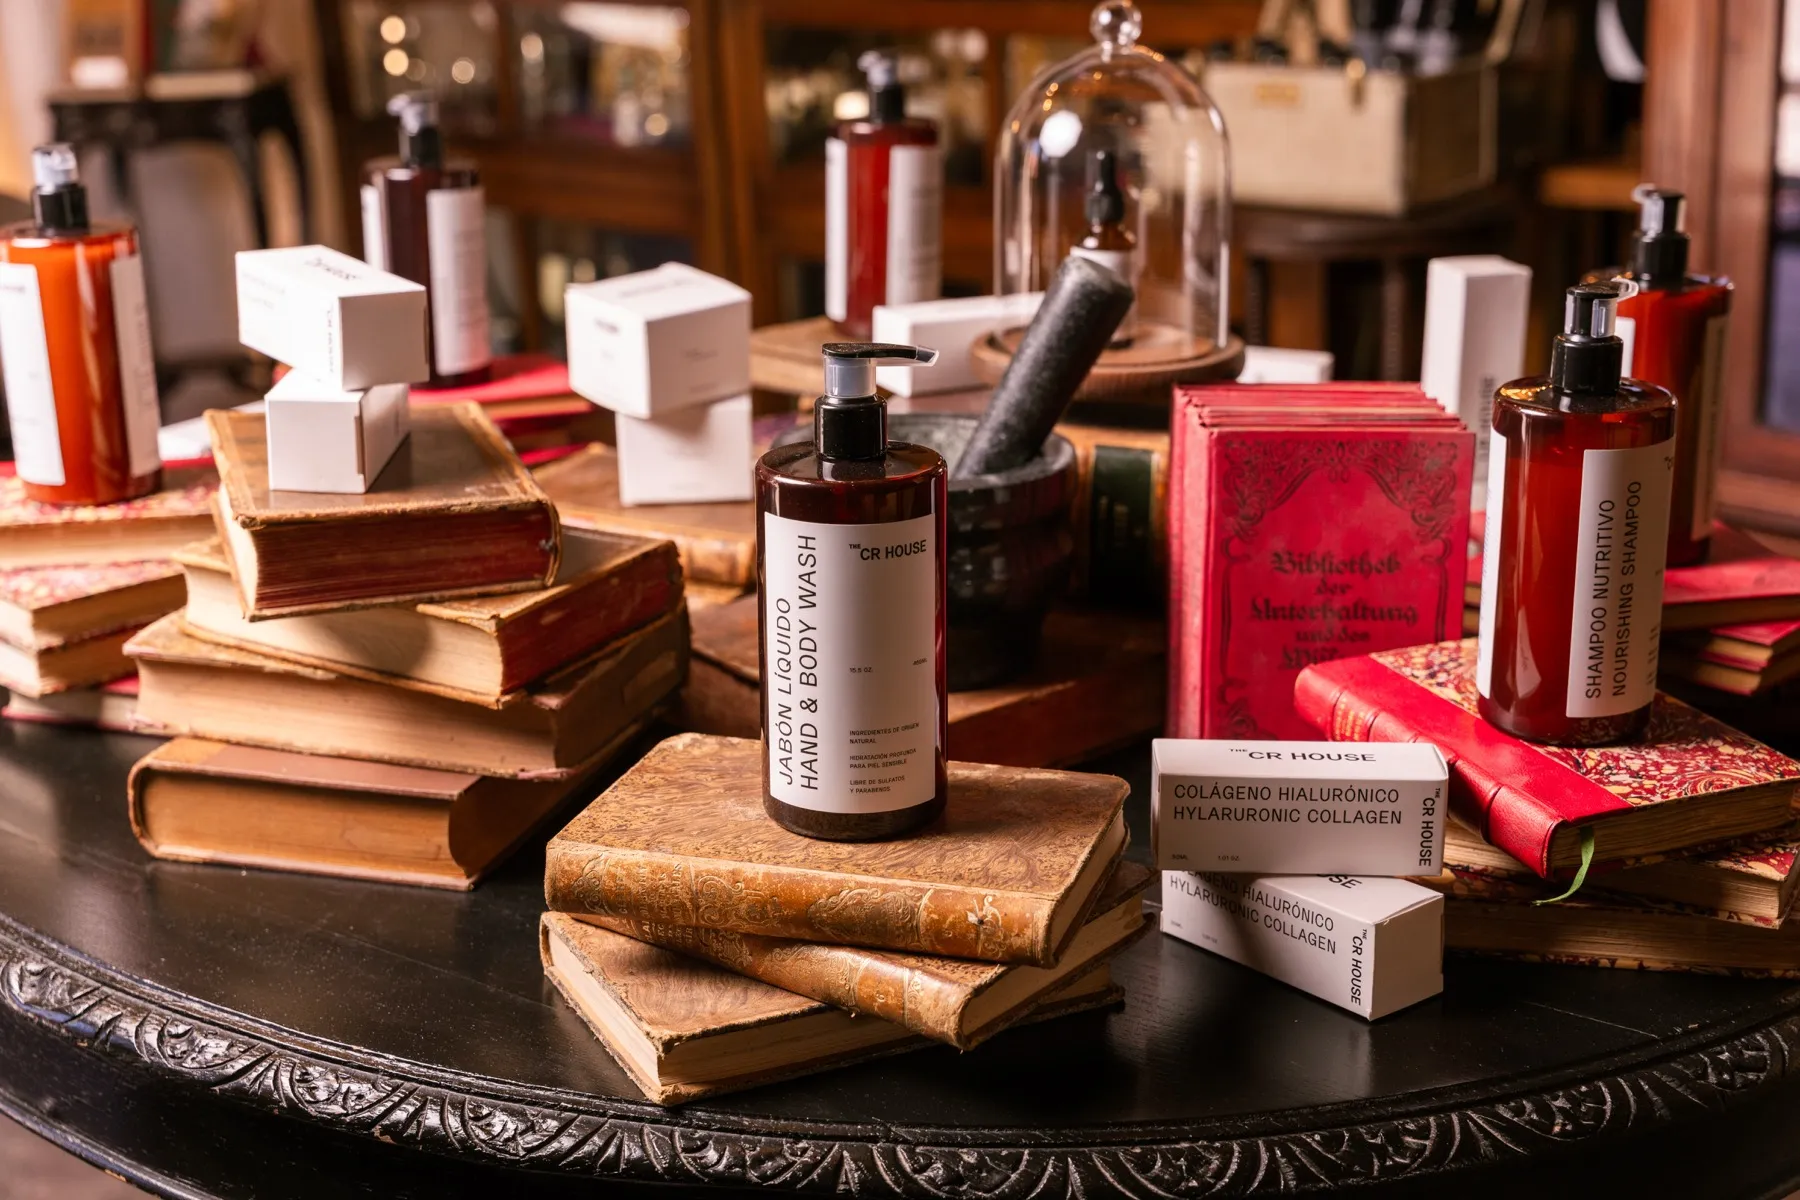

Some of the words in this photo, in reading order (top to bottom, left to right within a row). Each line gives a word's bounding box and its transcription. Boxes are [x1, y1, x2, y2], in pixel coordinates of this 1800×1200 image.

[860, 547, 880, 561] CR
[885, 539, 927, 559] HOUSE
[1593, 500, 1615, 600] NUTRITIVO
[1621, 481, 1641, 576] SHAMPOO
[797, 535, 817, 609] WASH
[774, 598, 792, 695] LÍQUIDO
[798, 619, 818, 687] BODY
[1586, 607, 1607, 699] SHAMPOO
[1612, 583, 1634, 696] NOURISHING
[799, 698, 818, 713] &
[775, 703, 793, 785] JABÓN
[849, 728, 892, 736] INGREDIENTES
[889, 748, 917, 758] PROFUNDA
[800, 723, 818, 790] HAND
[878, 775, 905, 784] SULFATOS
[882, 759, 907, 768] SENSIBLE
[1248, 751, 1283, 760] CR
[1291, 752, 1377, 762] HOUSE
[856, 786, 891, 794] PARABENOS
[1174, 781, 1271, 800] COLÁGENO
[1278, 784, 1400, 803] HIALURÓNICO
[1422, 797, 1436, 817] CR
[1173, 806, 1301, 823] HYLARURONIC
[1307, 808, 1402, 825] COLLAGEN
[1418, 820, 1434, 867] HOUSE
[1170, 875, 1260, 923] HYLARURONIC
[1264, 914, 1336, 955] COLLAGEN
[1242, 884, 1335, 932] HIALURÓNICO
[1352, 936, 1363, 956] CR
[1351, 958, 1363, 1006] HOUSE
